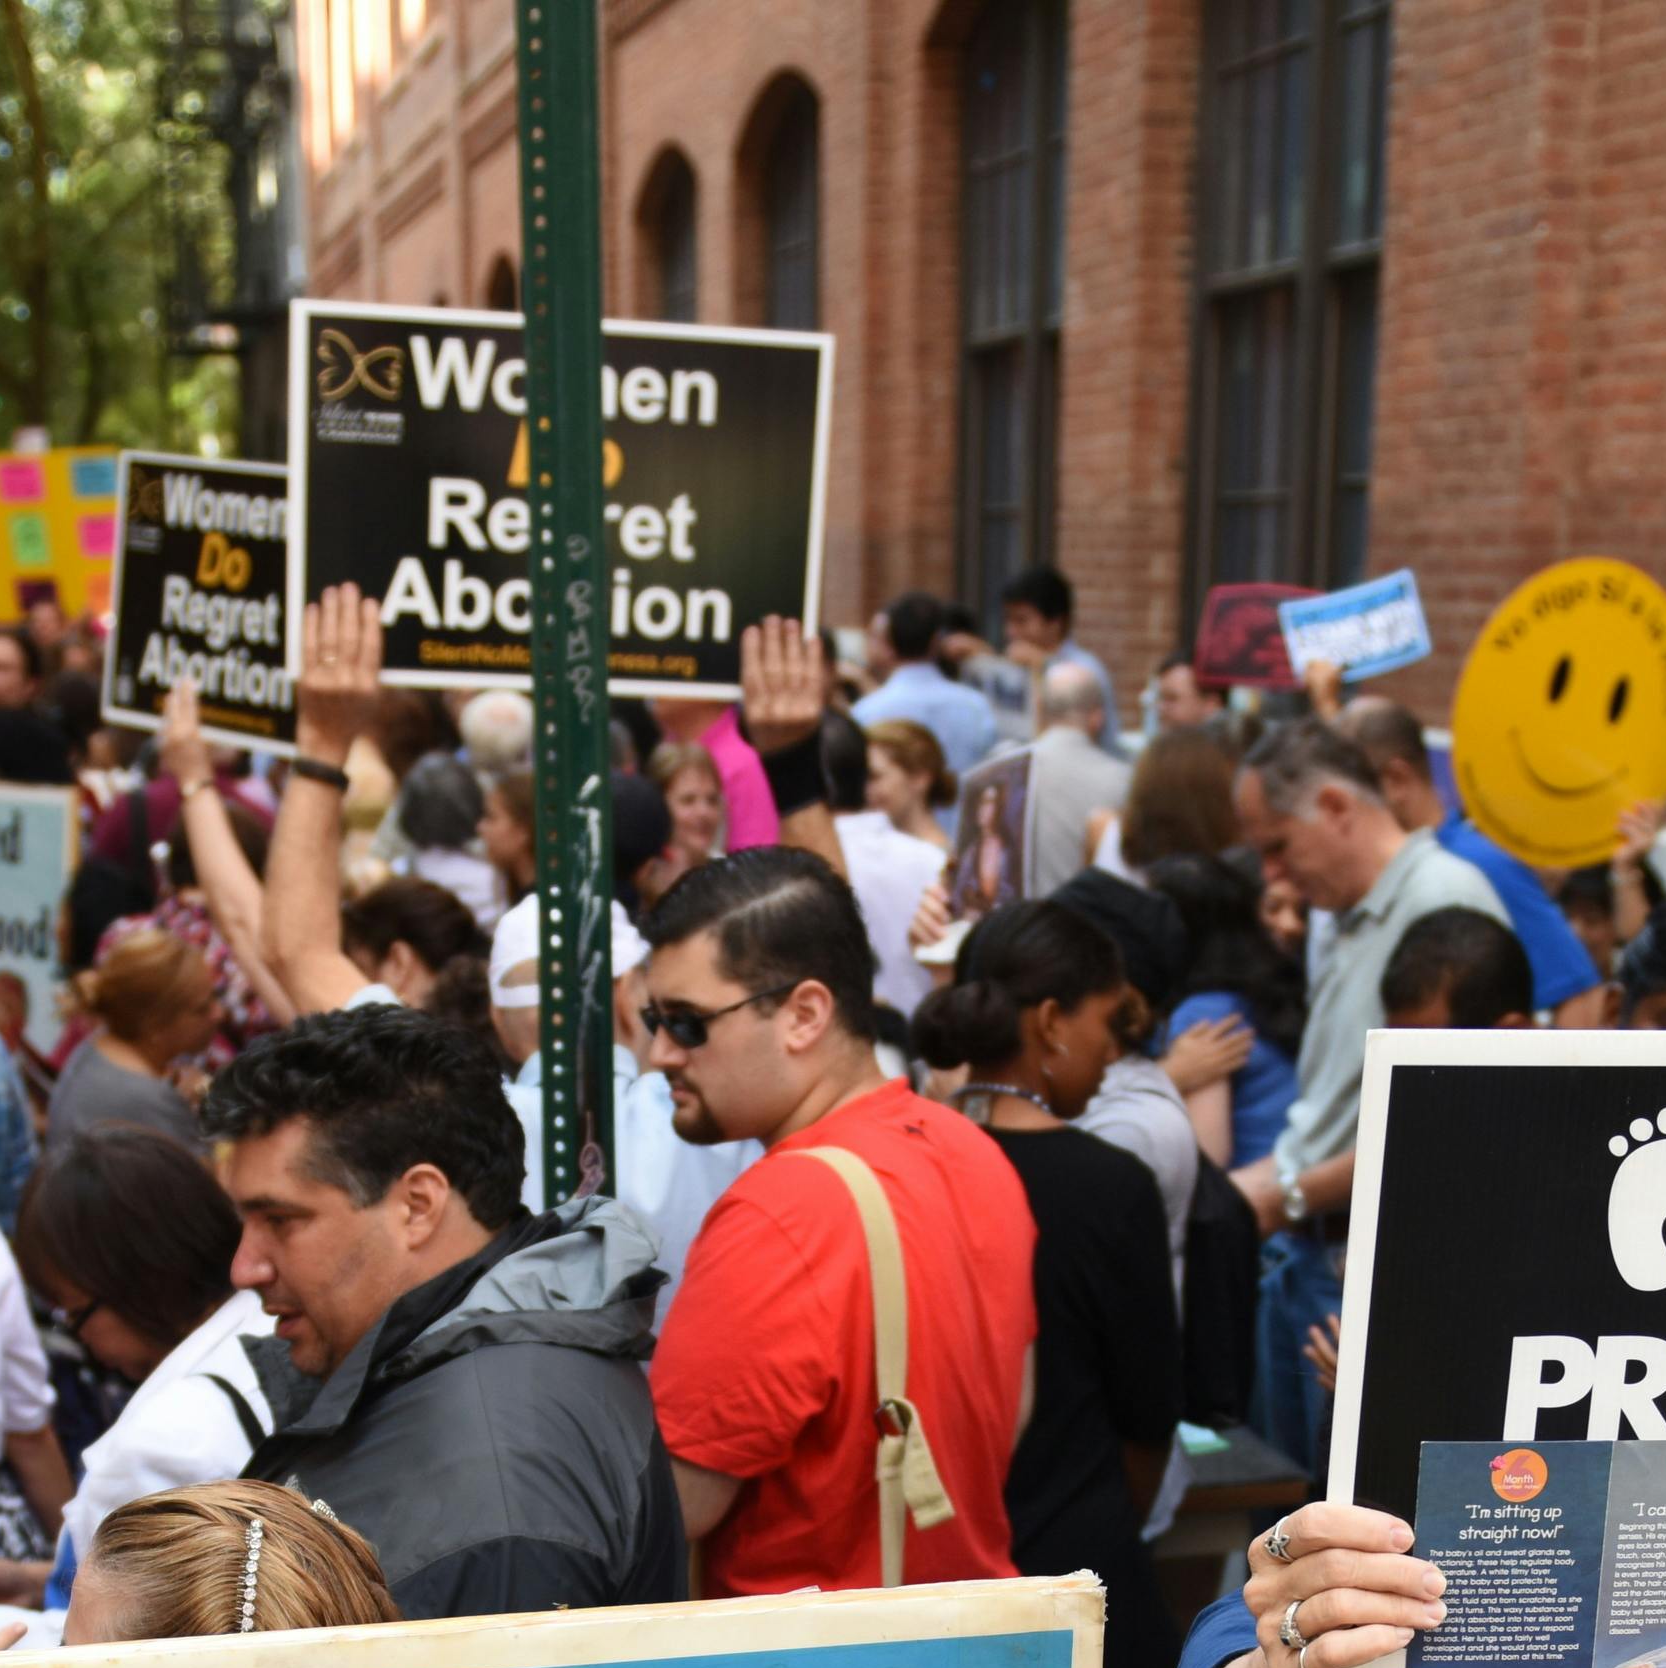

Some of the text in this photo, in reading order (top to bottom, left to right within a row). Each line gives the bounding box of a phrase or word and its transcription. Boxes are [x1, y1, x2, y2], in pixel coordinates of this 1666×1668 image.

[408, 333, 718, 426] Woen
[428, 476, 699, 562] Reet
[197, 530, 252, 592] Do
[162, 574, 281, 650] Regret
[379, 557, 732, 643] Aboion
[139, 631, 294, 712] Abortion
[1504, 1474, 1534, 1484] Month
[1459, 1525, 1519, 1544] straight
[1494, 1505, 1541, 1523] sitting
[1543, 1507, 1562, 1521] up
[1619, 1523, 1656, 1531] Beginning
